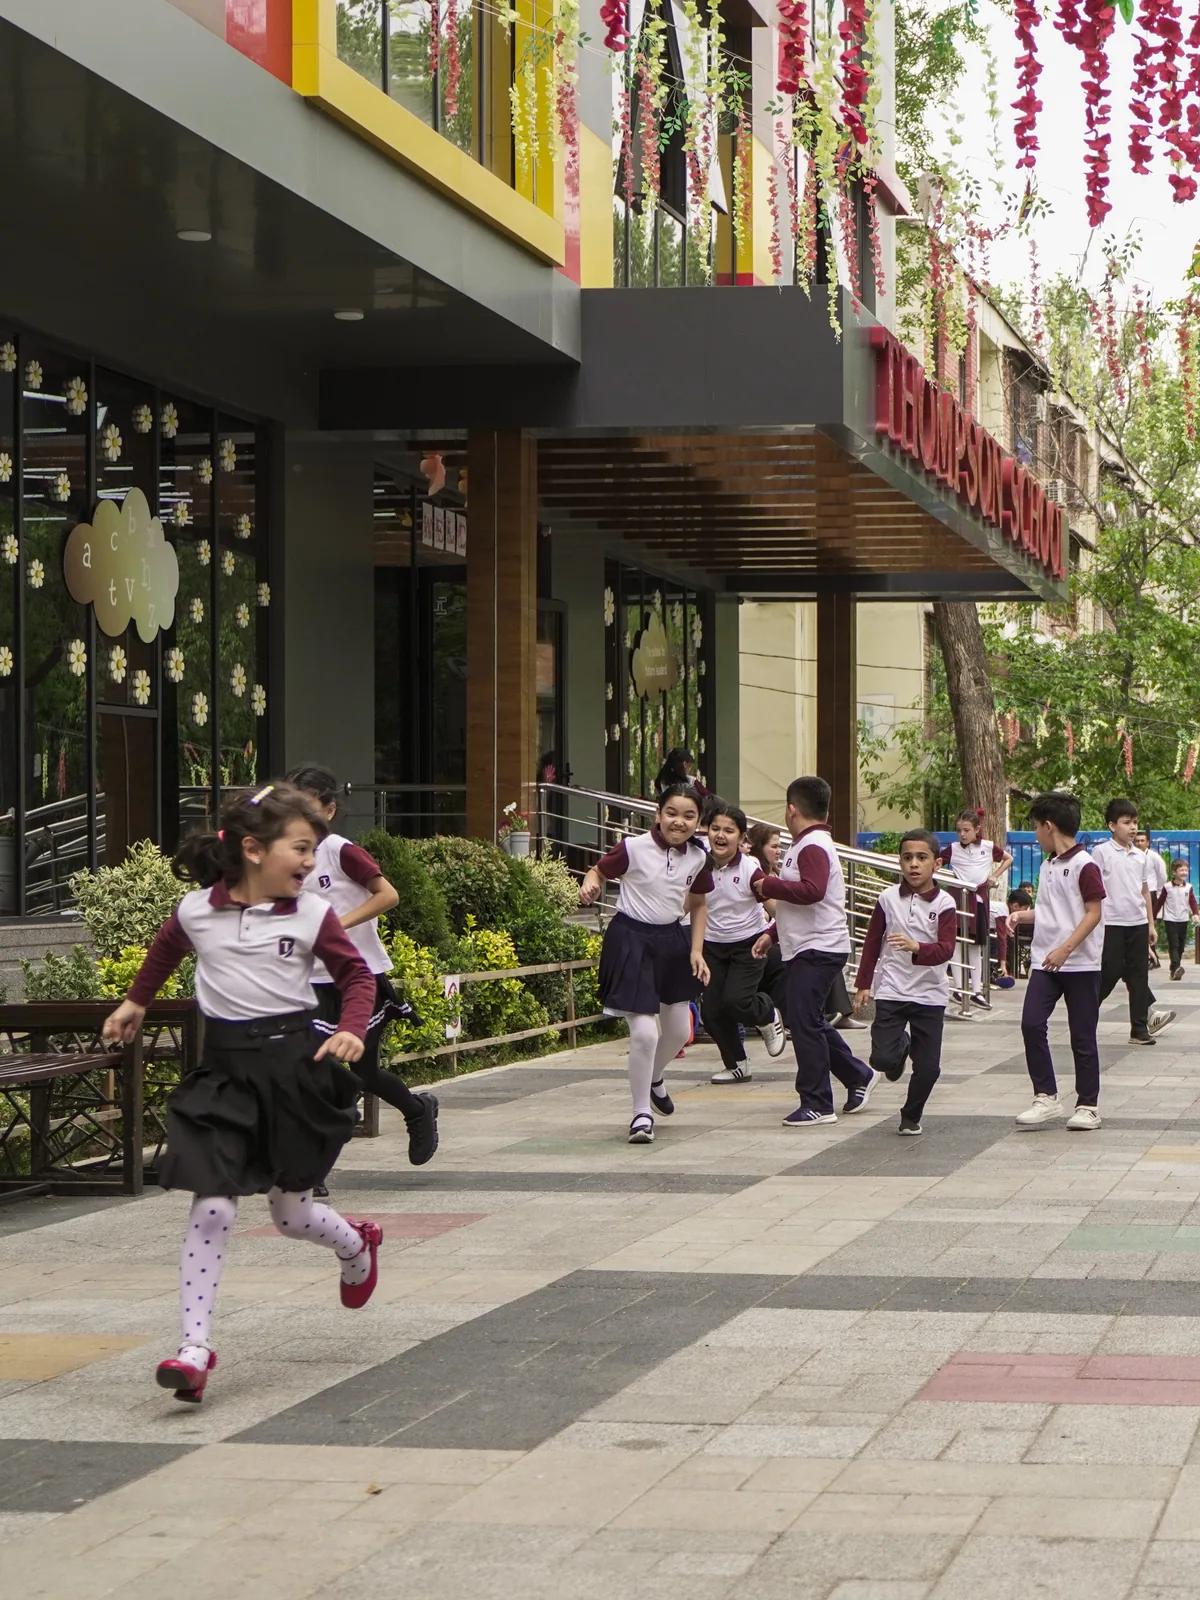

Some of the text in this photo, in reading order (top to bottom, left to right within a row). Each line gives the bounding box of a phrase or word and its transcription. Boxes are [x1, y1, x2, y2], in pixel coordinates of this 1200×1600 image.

[868, 326, 1066, 581] THOMPSON SCHOOL
[111, 532, 118, 551] c
[83, 543, 91, 568] a
[109, 579, 117, 606] t
[125, 578, 135, 602] v
